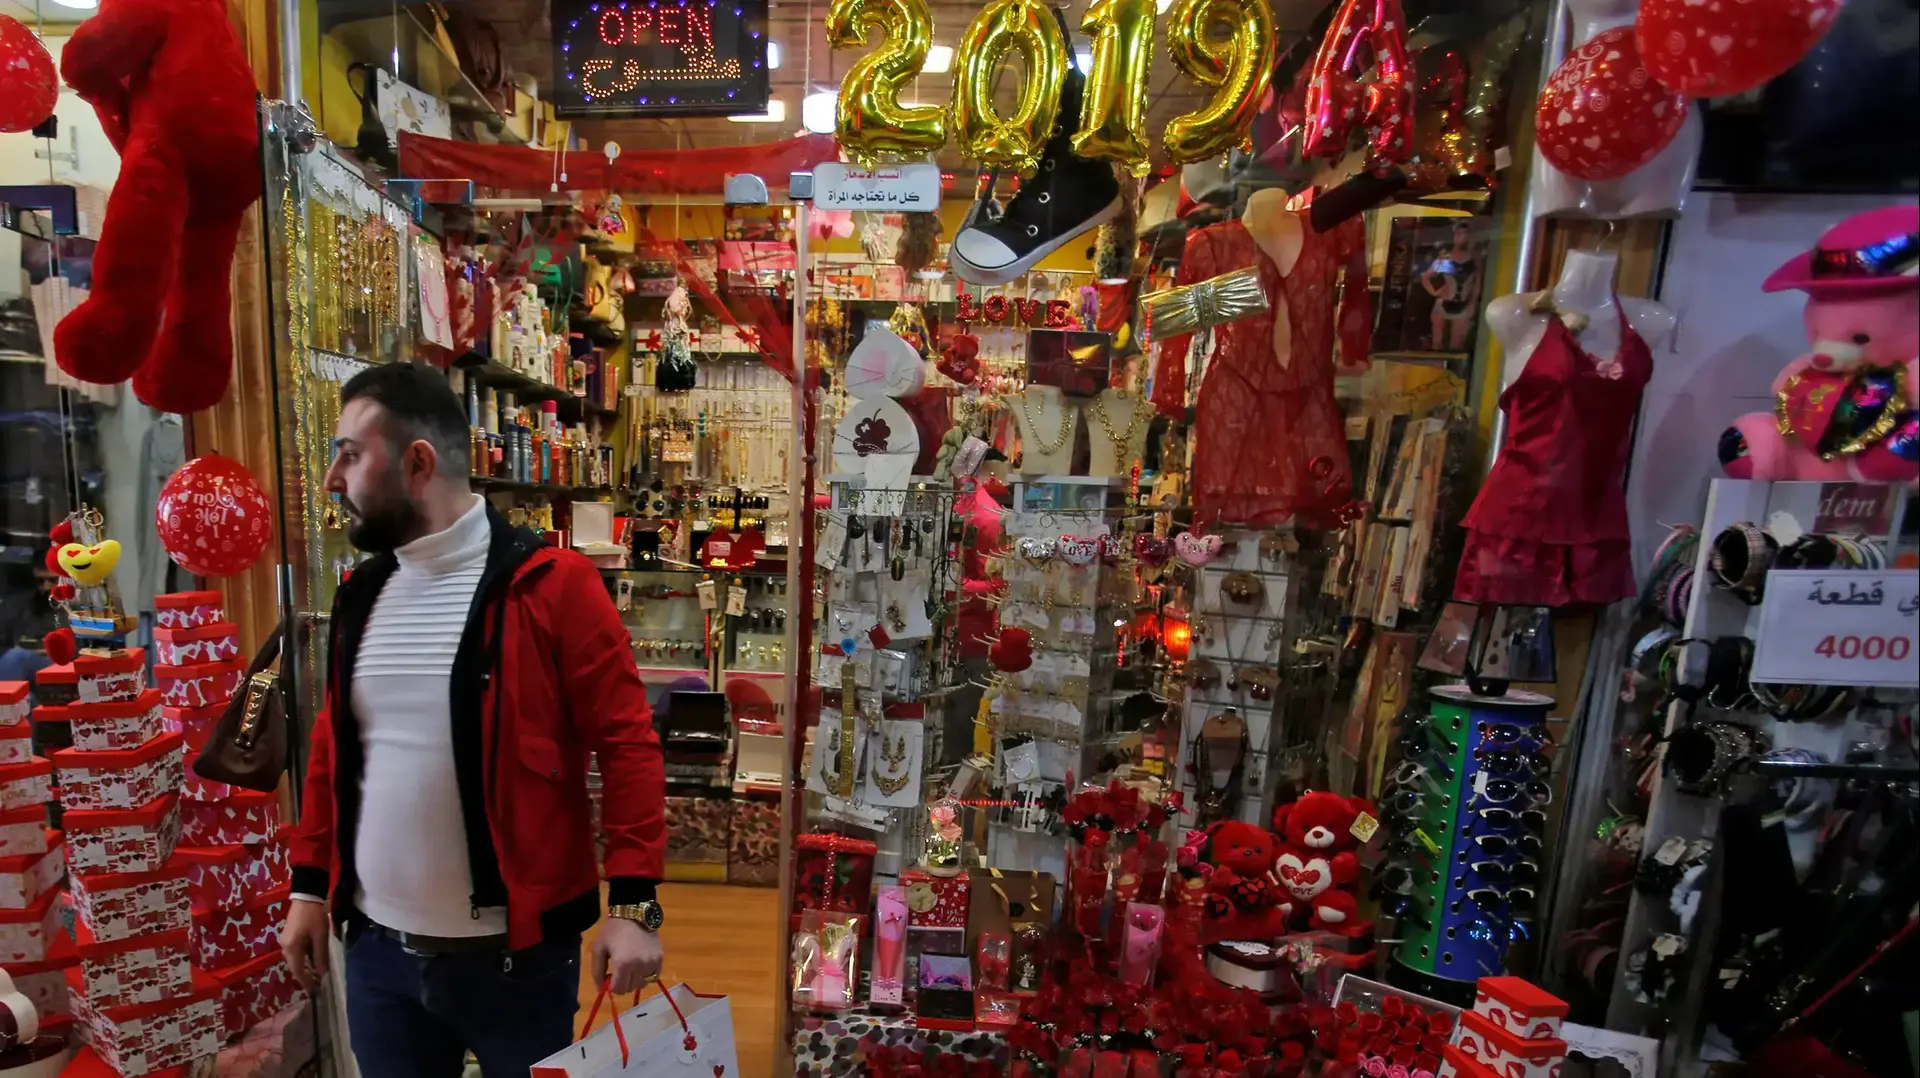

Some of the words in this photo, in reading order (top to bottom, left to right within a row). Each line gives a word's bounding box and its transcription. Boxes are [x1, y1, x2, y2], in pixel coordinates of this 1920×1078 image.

[600, 6, 711, 45] OPEN
[582, 43, 741, 98] مفتوح
[825, 0, 1278, 172] 2019
[888, 191, 897, 202] ما
[899, 190, 920, 204] كل
[956, 293, 1072, 327] LOVE
[1816, 486, 1877, 519] dem
[1807, 580, 1884, 606] قطعة
[1813, 634, 1911, 662] 4000
